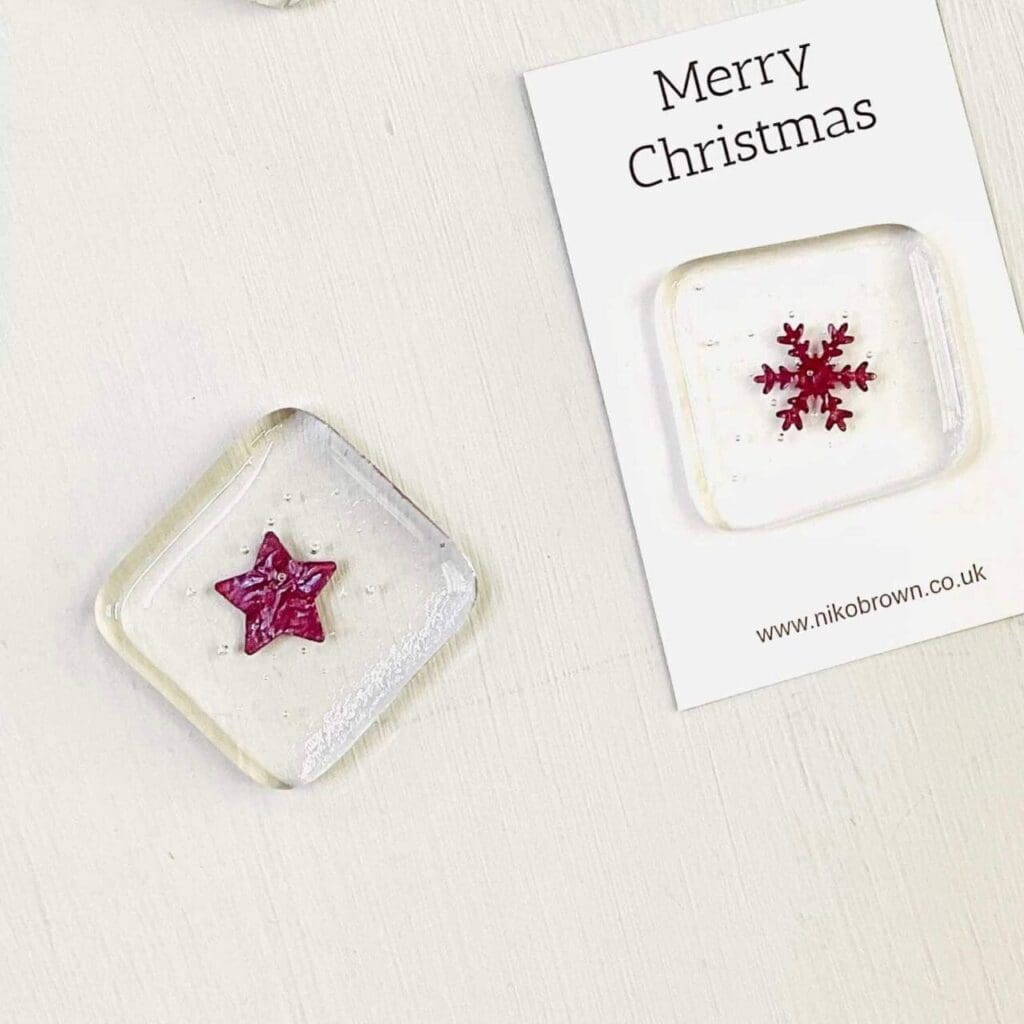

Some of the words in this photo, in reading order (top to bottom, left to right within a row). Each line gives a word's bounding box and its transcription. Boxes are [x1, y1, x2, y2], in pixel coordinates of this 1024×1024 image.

[652, 42, 812, 112] Merry
[628, 98, 878, 189] Christmas
[756, 563, 987, 644] www.nikobrown.co.uk
